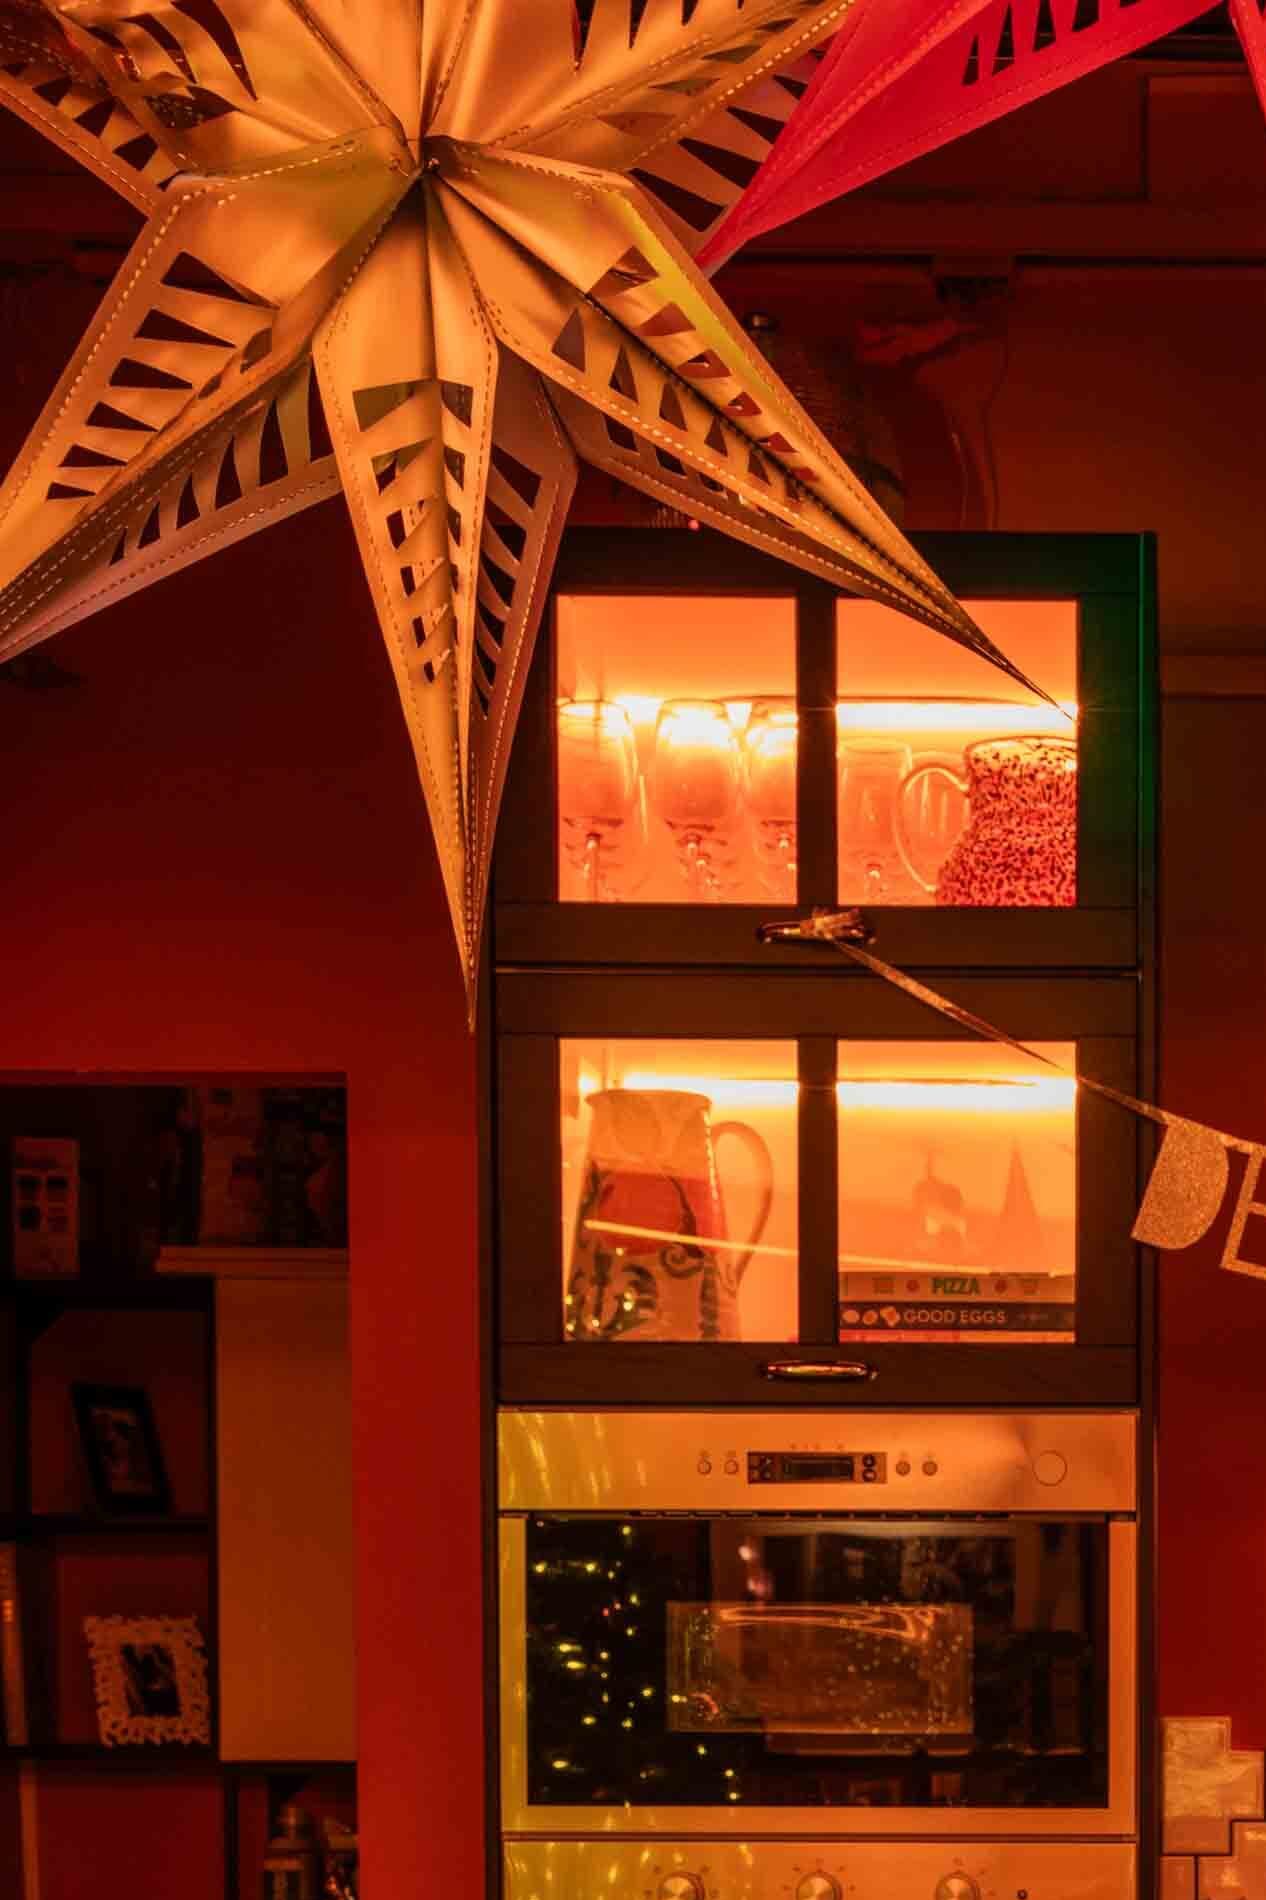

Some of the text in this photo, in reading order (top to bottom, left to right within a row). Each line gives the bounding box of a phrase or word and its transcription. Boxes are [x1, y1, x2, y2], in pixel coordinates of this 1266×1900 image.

[931, 1277, 981, 1296] PIZZA
[903, 1308, 955, 1325] GOOD
[959, 1308, 1007, 1325] EGGS
